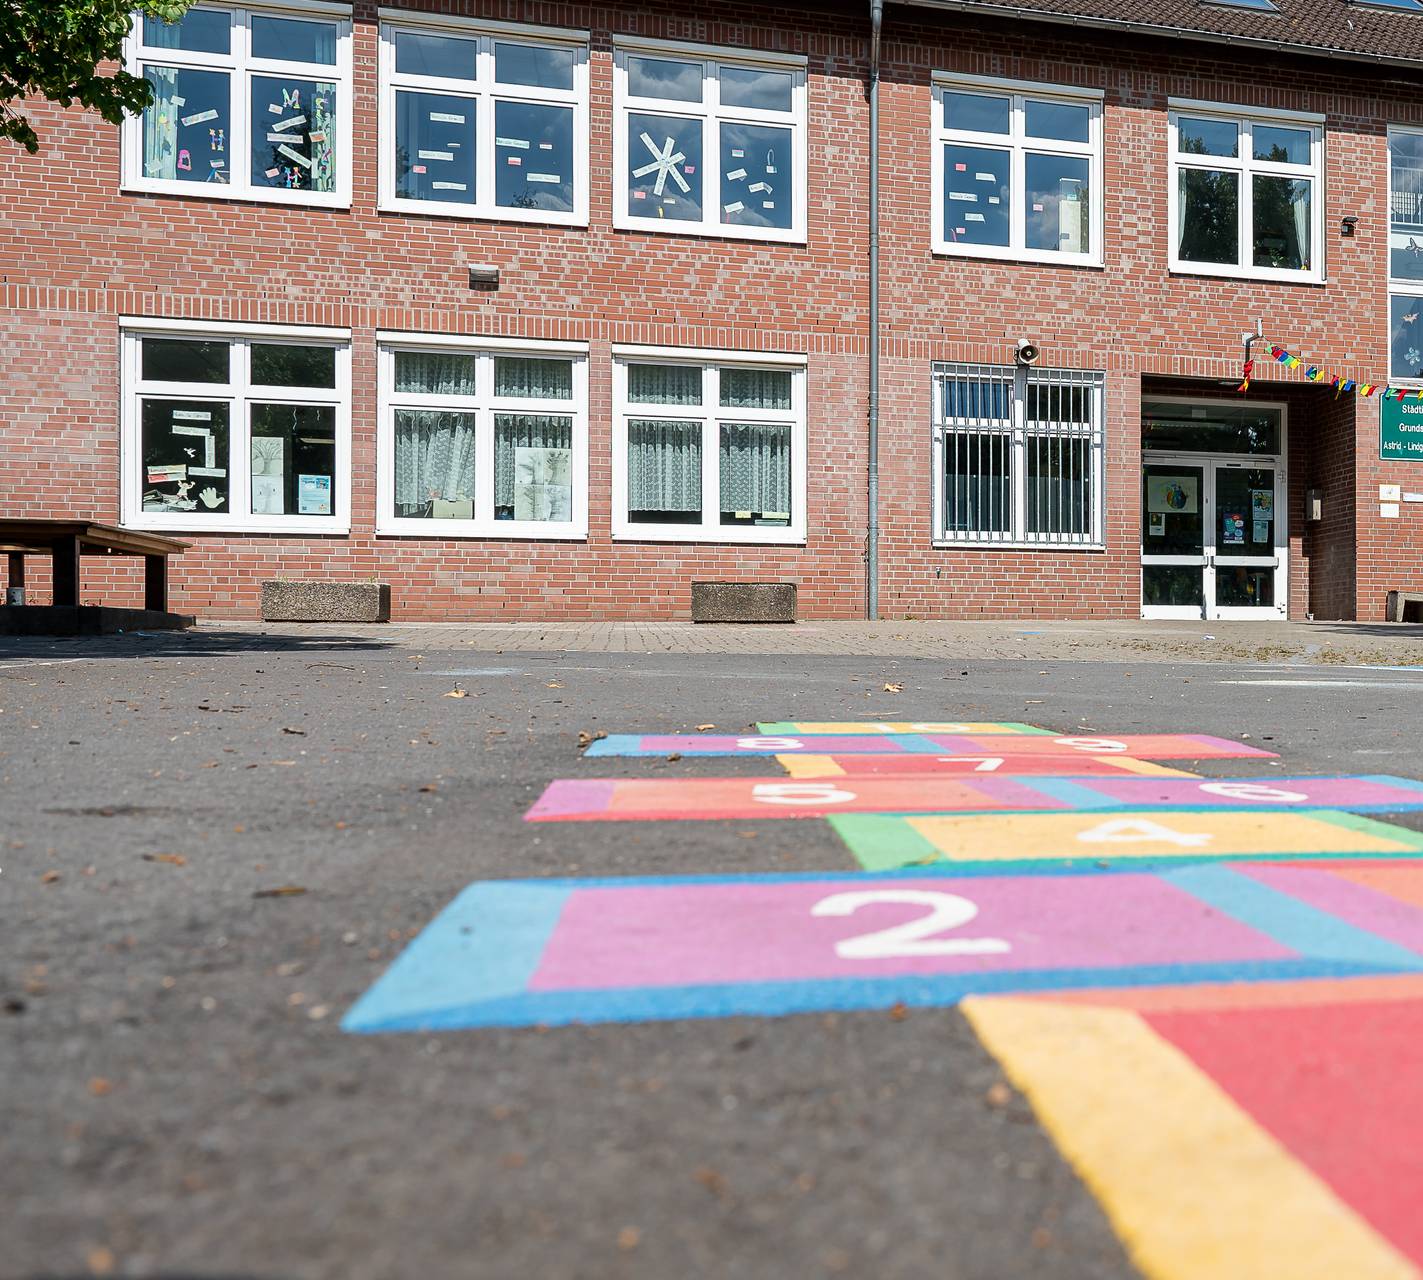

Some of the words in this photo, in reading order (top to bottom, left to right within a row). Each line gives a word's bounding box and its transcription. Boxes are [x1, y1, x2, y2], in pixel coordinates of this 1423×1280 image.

[1383, 441, 1402, 450] Astrid
[867, 722, 972, 734] 10
[736, 737, 806, 750] 8
[1053, 737, 1129, 752] 9
[937, 757, 1006, 771] 7
[751, 783, 858, 805] 5
[1198, 782, 1310, 803] 6
[1074, 818, 1214, 847] 4
[810, 888, 1012, 960] 2
